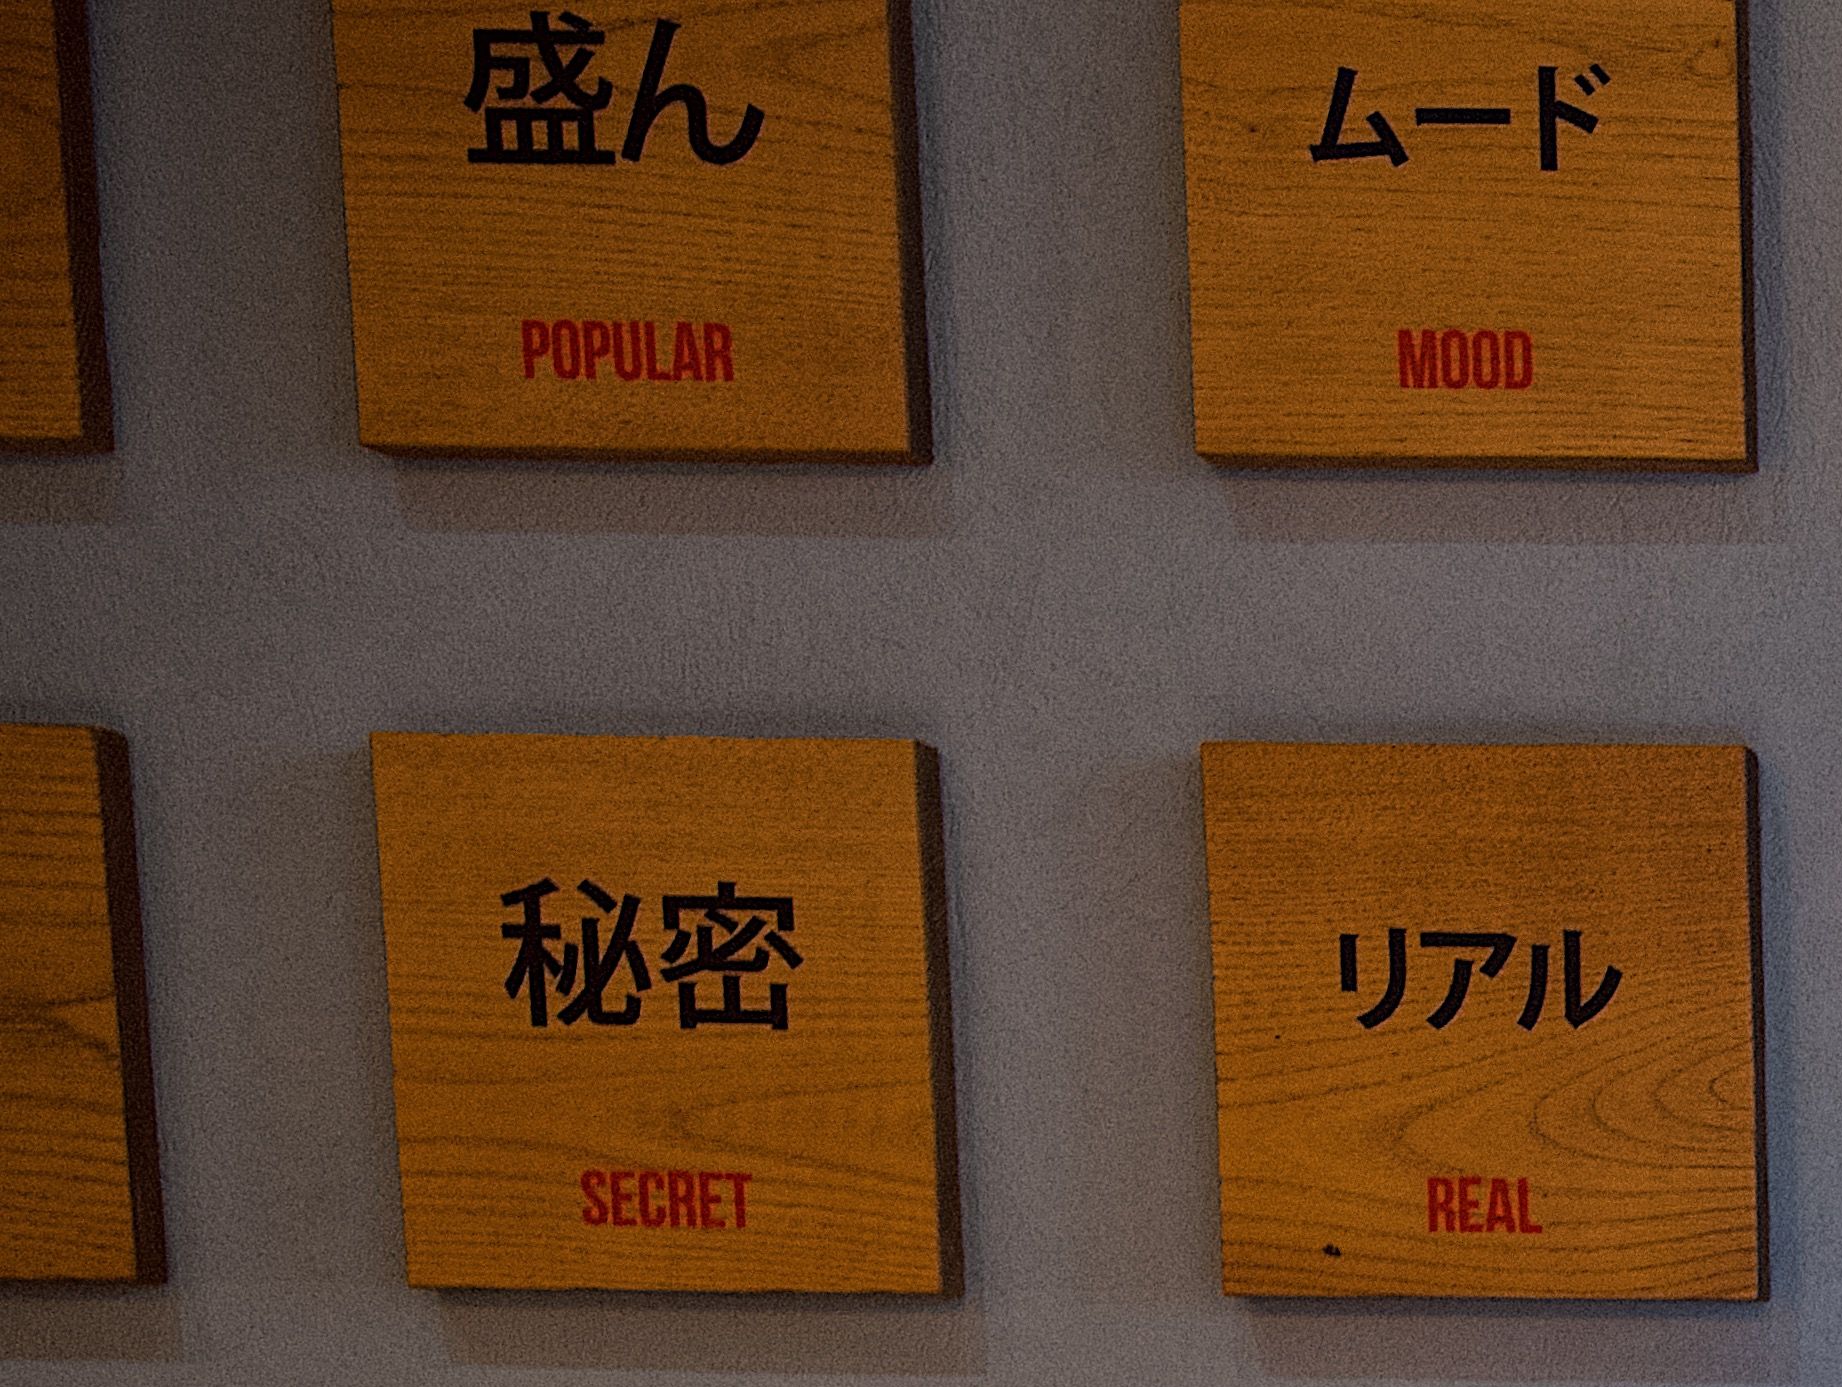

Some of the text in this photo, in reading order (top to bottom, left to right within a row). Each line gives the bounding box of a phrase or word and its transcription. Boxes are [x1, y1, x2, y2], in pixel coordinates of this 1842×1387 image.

[464, 12, 763, 165] 盛ん
[1310, 65, 1609, 170] ムード
[523, 321, 733, 382] POPULAR
[1399, 329, 1532, 390] MOOD
[502, 880, 802, 1030] 秘密
[1340, 928, 1621, 1029] リアル
[581, 1170, 751, 1228] SECRET
[1428, 1176, 1541, 1233] REAL
